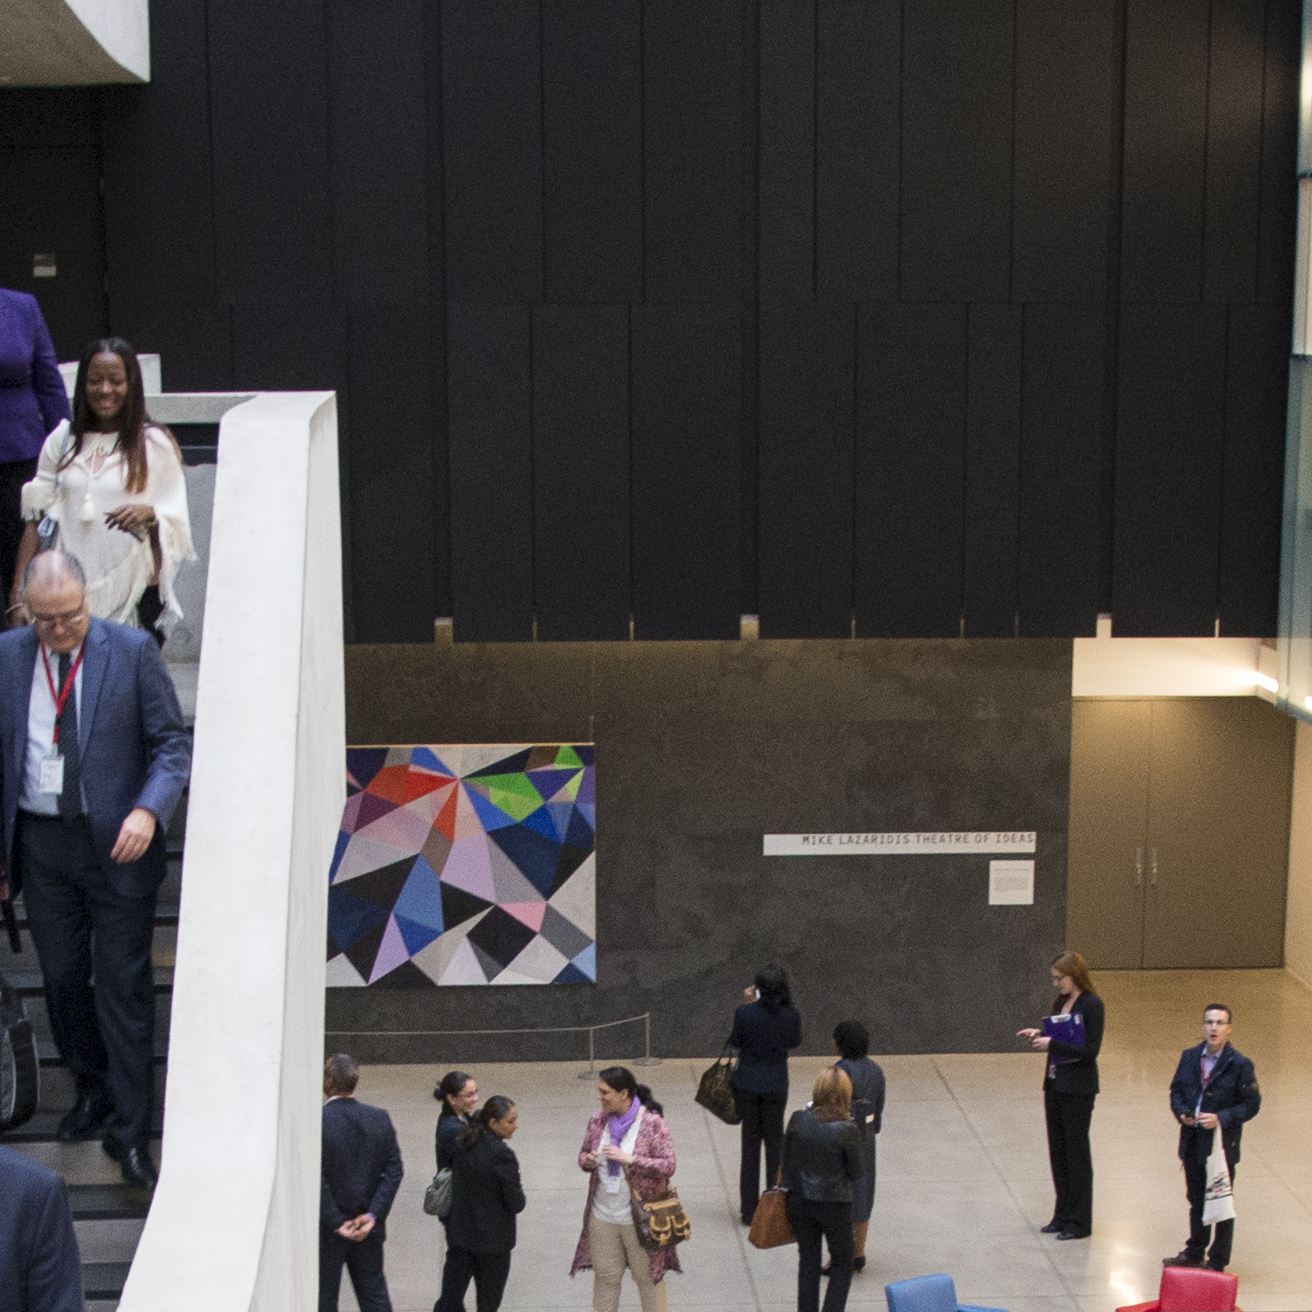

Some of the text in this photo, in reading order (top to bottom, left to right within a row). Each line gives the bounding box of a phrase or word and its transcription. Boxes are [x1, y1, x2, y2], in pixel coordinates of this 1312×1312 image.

[802, 833, 1034, 847] MIKE LAZARIDIS THEATRE OF IDEAS
